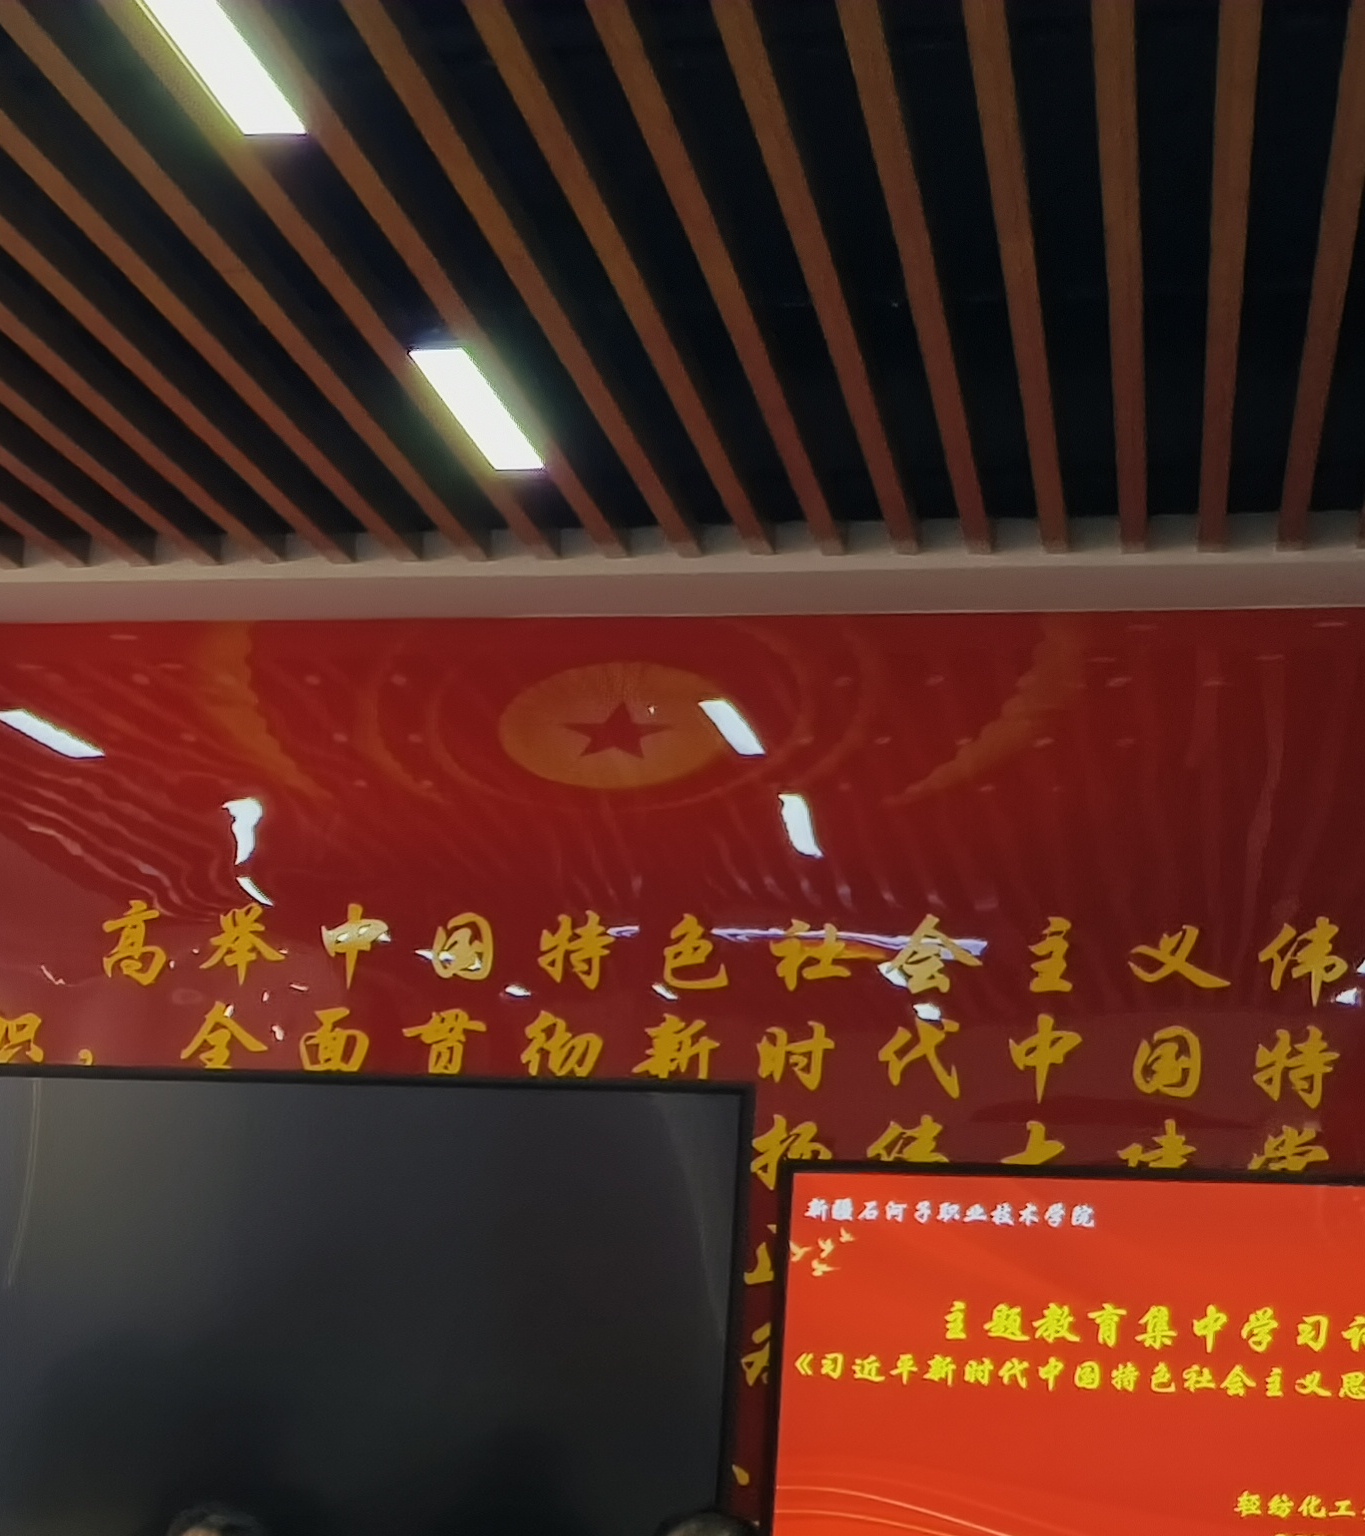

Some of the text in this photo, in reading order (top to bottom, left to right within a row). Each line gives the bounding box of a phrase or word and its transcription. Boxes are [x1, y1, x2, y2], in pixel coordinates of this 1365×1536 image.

[102, 899, 1348, 1007] 高举中国特色社会主义伟
[804, 1197, 1096, 1228] 新疆石河子职业技术学院
[794, 1353, 1365, 1400] 《习近平新时代中国特色社会主义思
[1233, 1490, 1365, 1520] 轻纺化工
